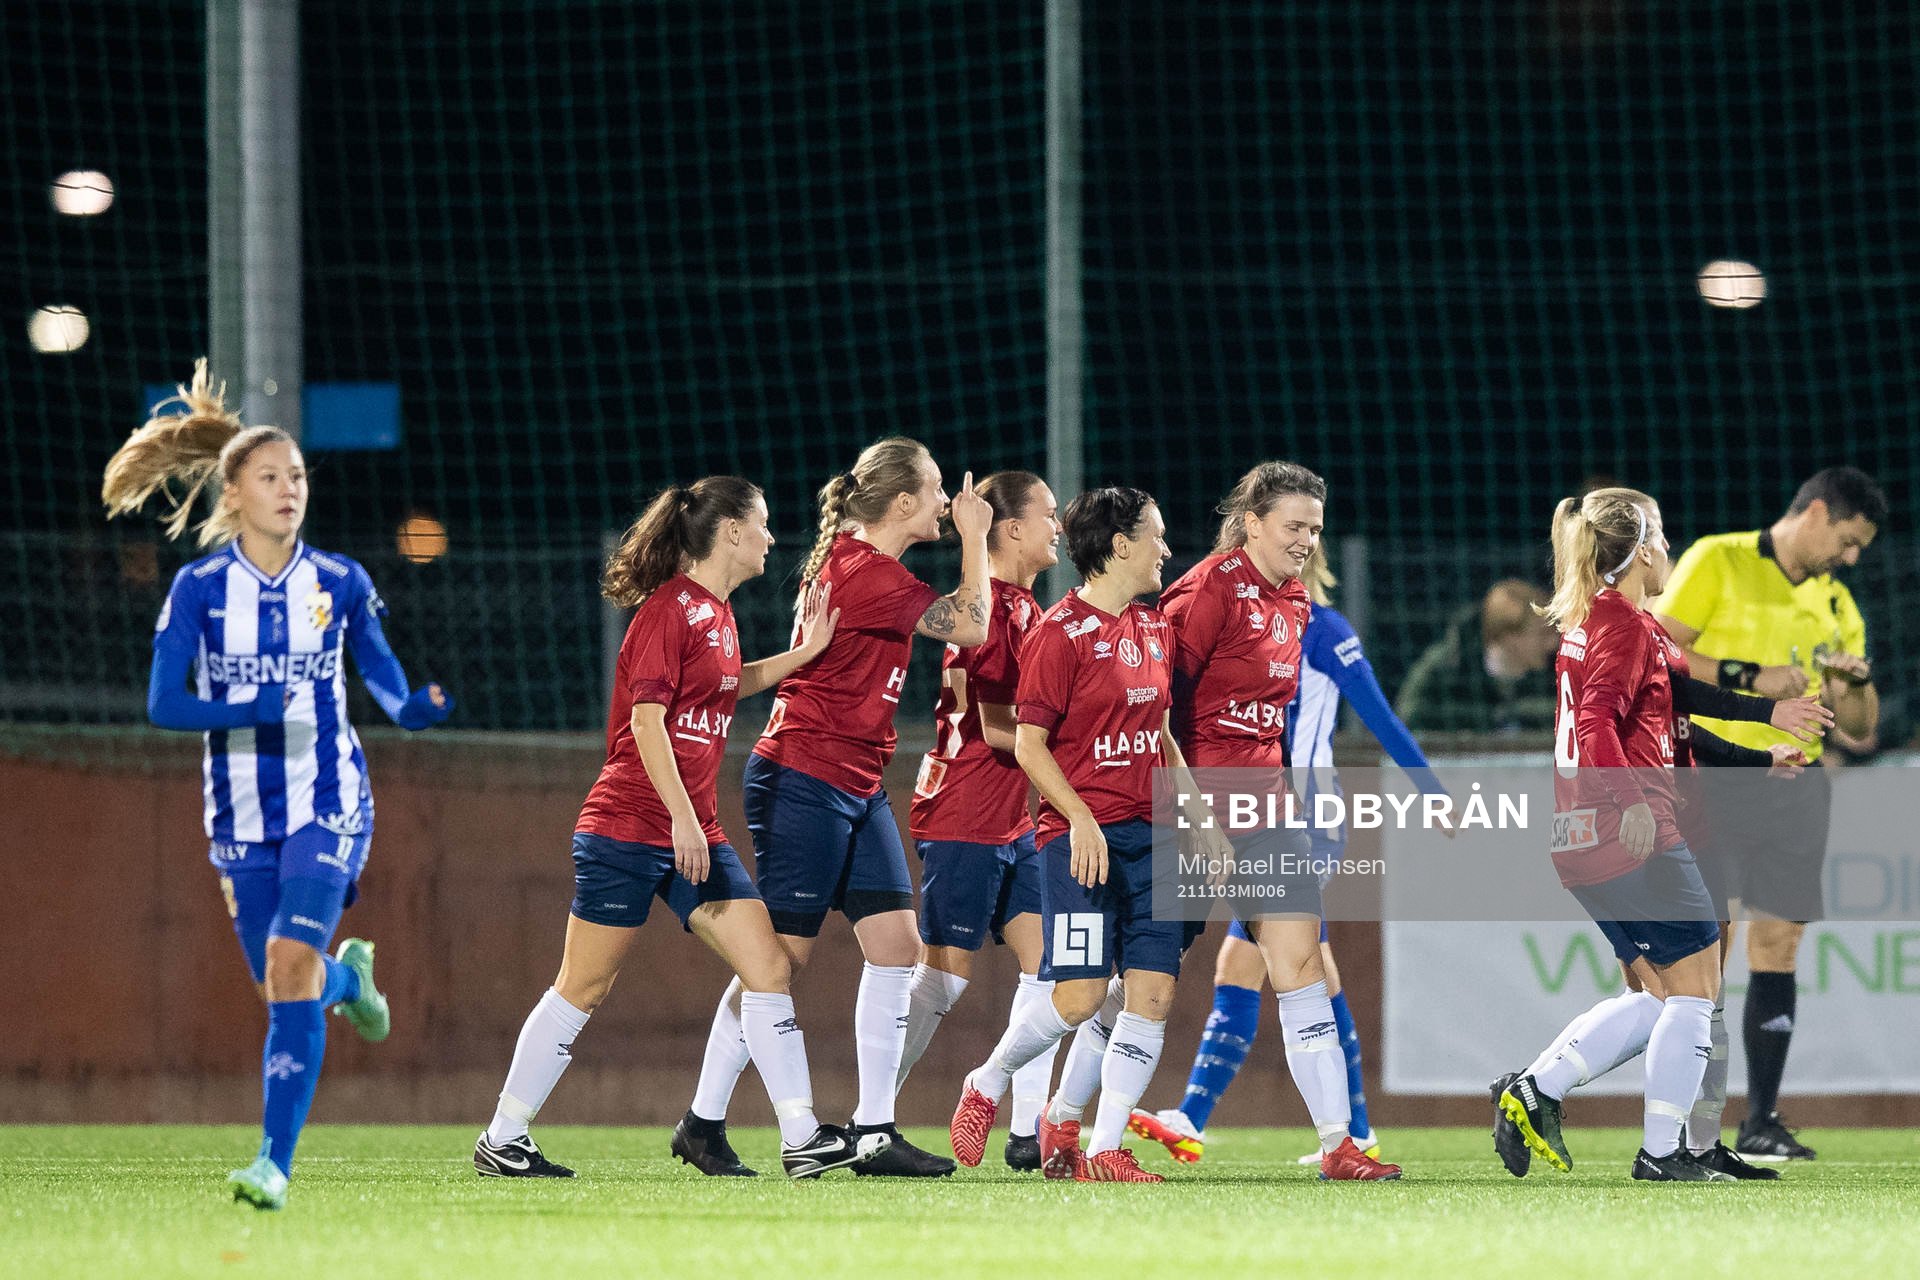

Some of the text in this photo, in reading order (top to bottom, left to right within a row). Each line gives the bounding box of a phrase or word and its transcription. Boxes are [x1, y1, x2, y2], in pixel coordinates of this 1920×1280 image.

[208, 651, 337, 684] SERNEKE
[1126, 686, 1158, 697] factoring
[1555, 671, 1580, 779] 6
[1301, 1028, 1336, 1041] umbro
[1112, 1048, 1148, 1065] umbro
[1517, 1079, 1539, 1112] PUMA
